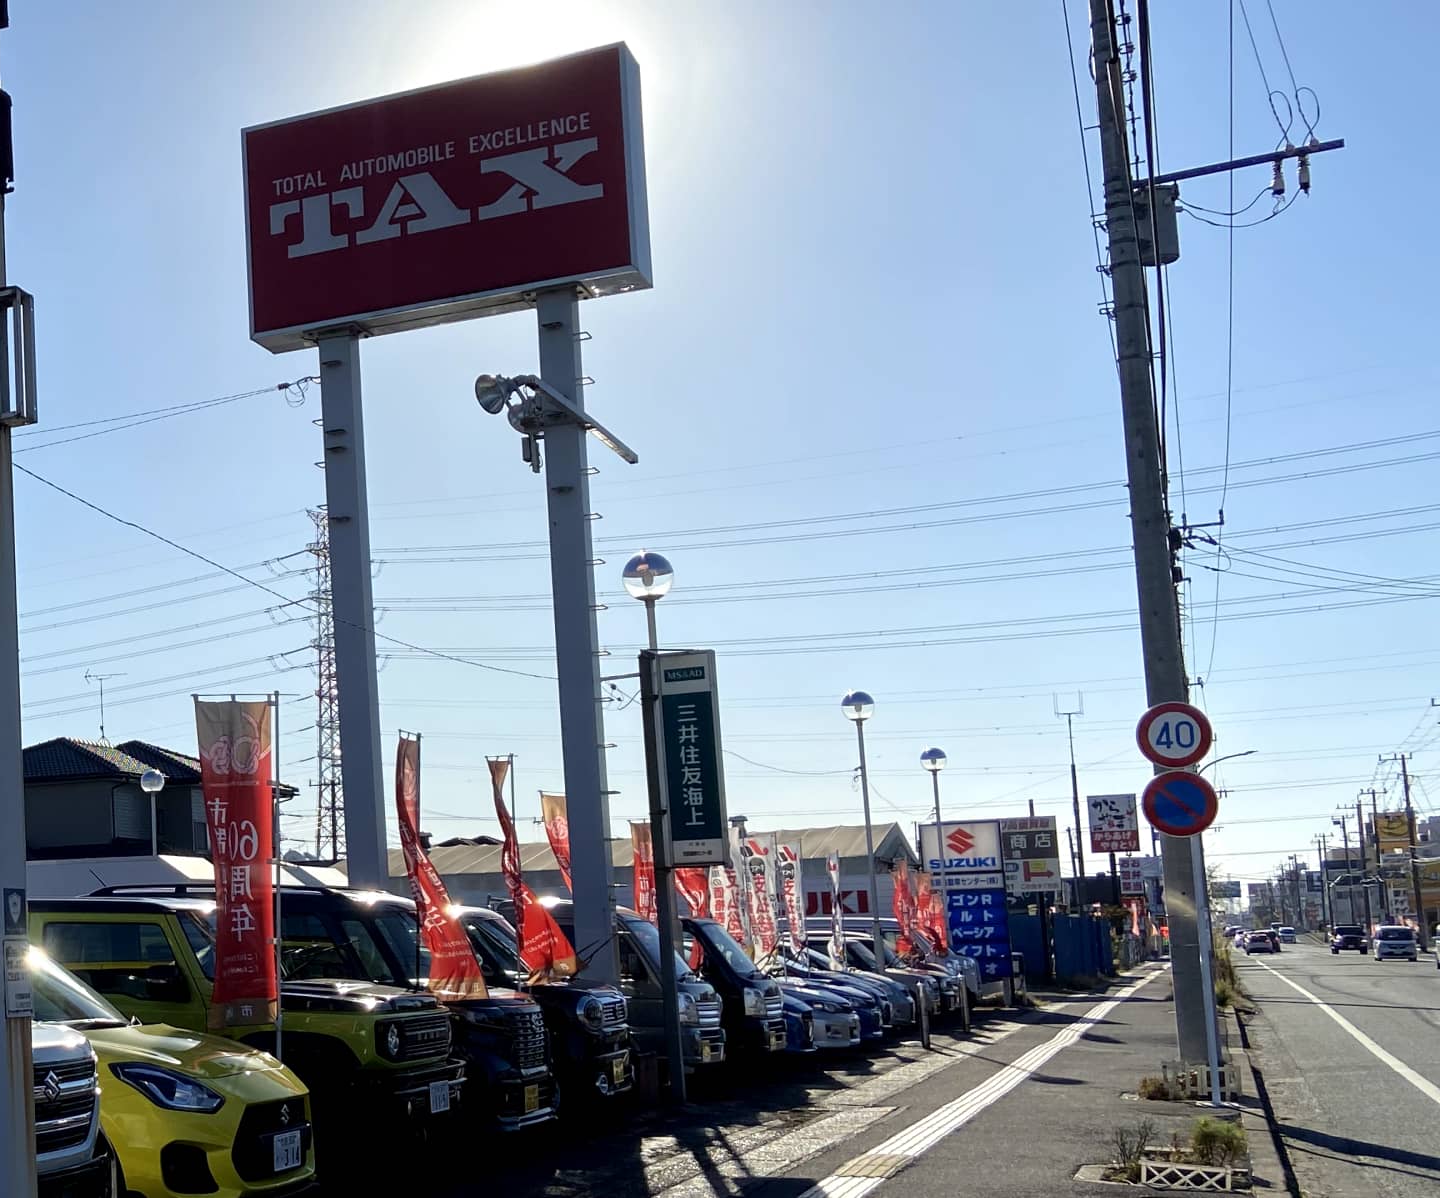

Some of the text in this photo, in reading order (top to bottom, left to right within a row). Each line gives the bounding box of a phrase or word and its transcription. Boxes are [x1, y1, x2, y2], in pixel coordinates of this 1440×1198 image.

[272, 112, 591, 196] TOTAL AUTOMOBILE EXCELLENCE
[269, 136, 604, 259] TAX
[1155, 720, 1195, 749] 40
[676, 703, 706, 827] 三井住友海上
[1010, 832, 1052, 849] 商店
[1094, 831, 1132, 841] からあげ
[1100, 841, 1138, 852] やきとり
[929, 856, 997, 870] SUZUKI
